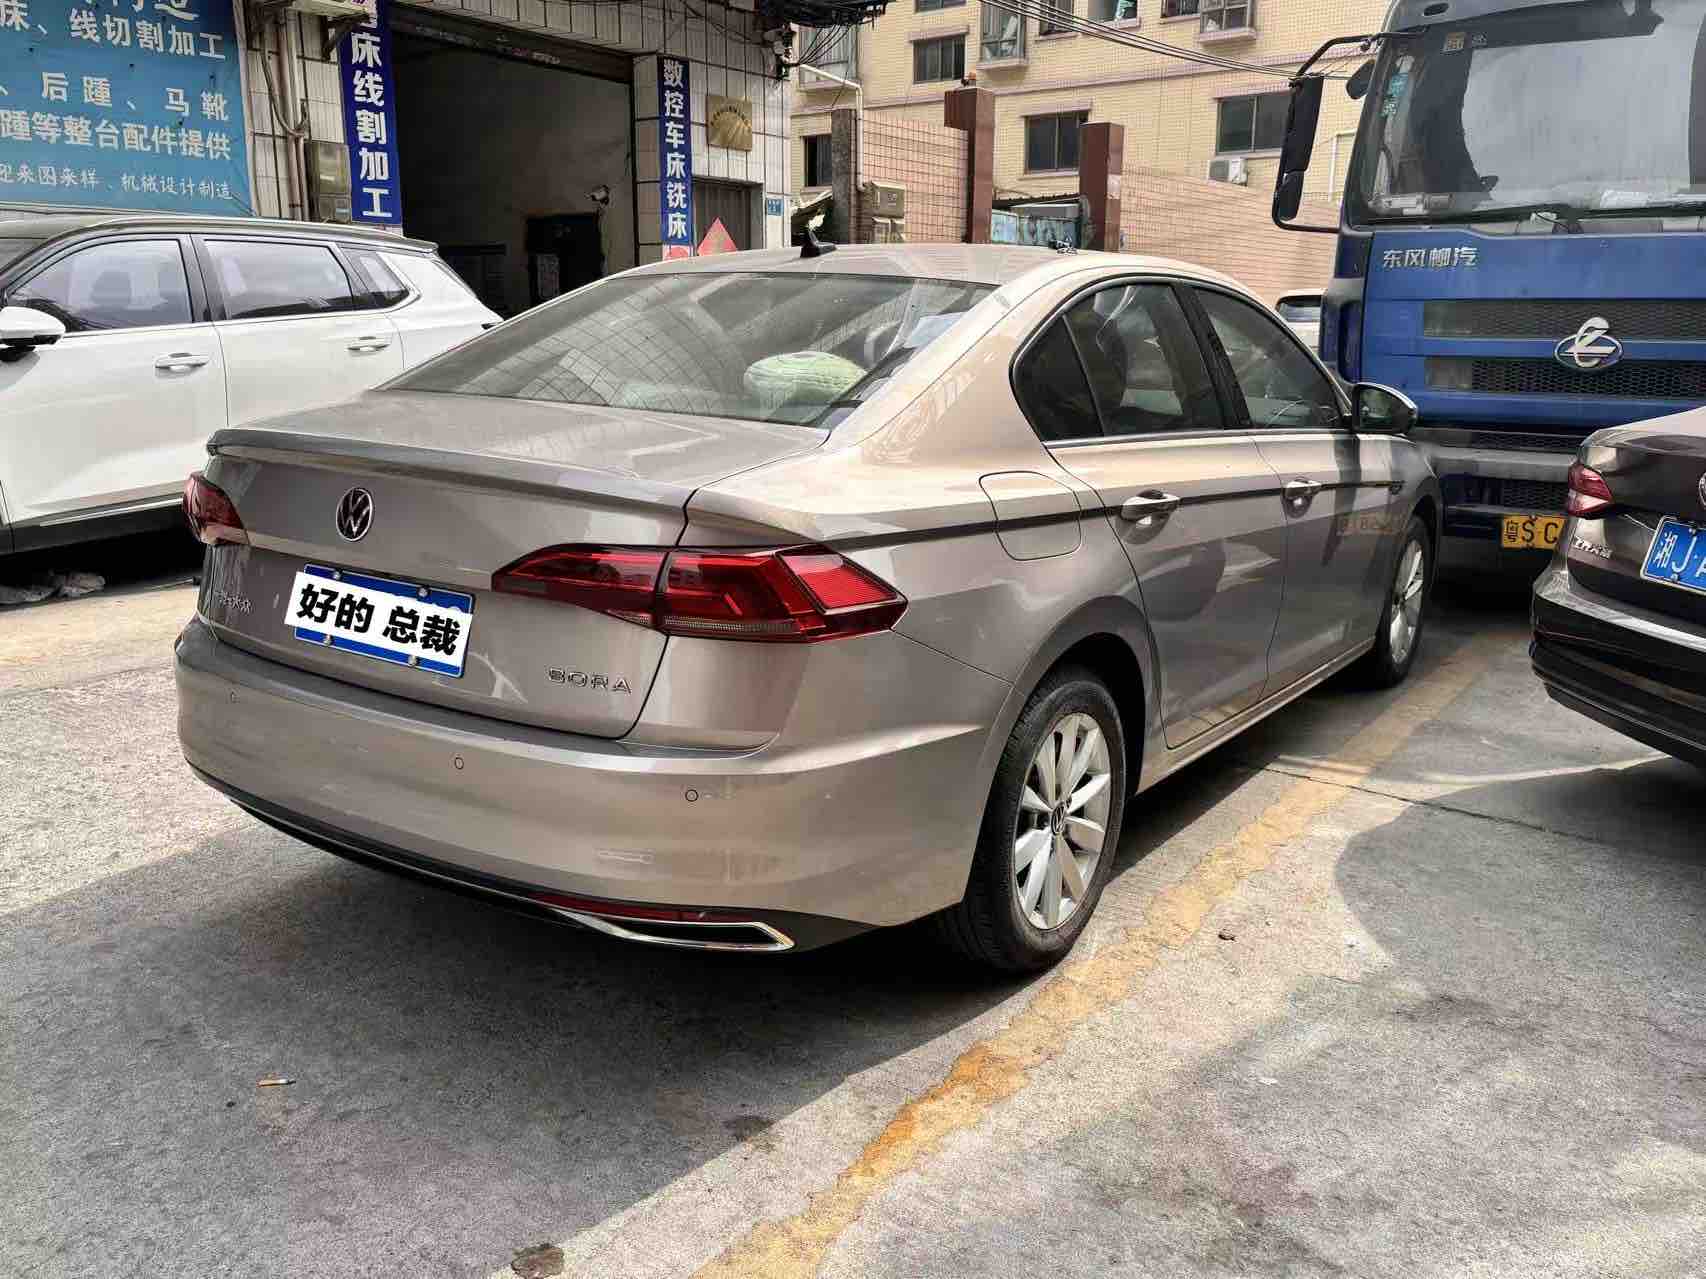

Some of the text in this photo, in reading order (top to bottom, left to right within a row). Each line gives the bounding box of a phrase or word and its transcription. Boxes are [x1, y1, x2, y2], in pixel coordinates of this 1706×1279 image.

[663, 59, 688, 240] 数控车床铣床
[1383, 246, 1478, 268] 东风柳汽
[548, 666, 633, 695] BORA
